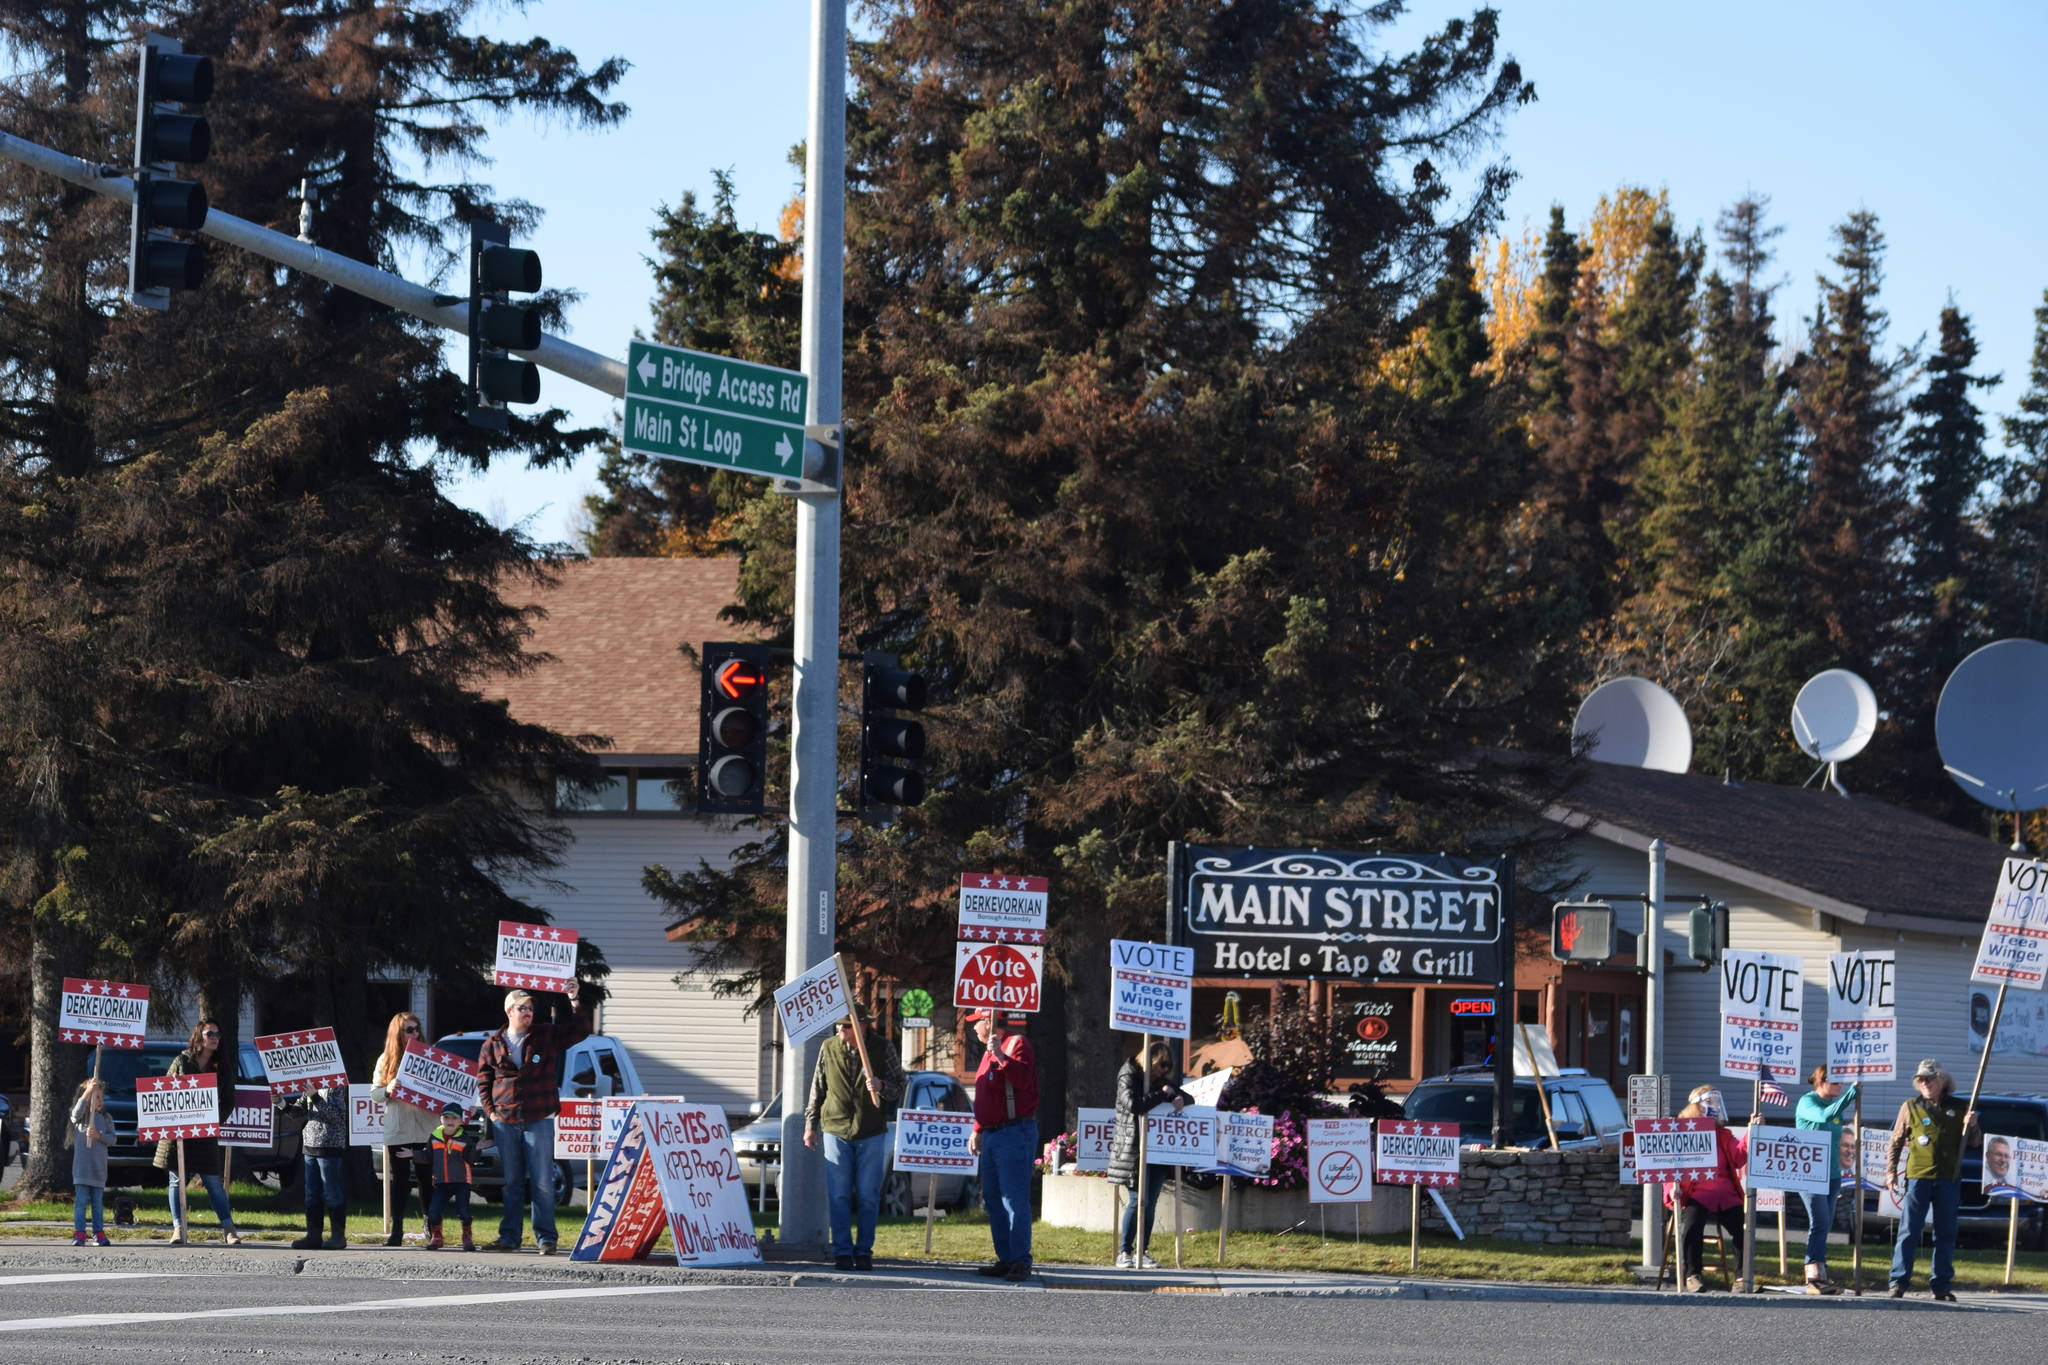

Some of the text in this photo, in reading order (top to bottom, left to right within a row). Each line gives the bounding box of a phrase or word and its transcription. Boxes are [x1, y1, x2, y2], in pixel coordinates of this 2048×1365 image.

[662, 356, 801, 414] Bridge Access Rd
[634, 406, 742, 464] Main St Loop
[965, 895, 1042, 915] DERKEVORKIAN
[1196, 883, 1495, 933] MAIN STREET
[977, 913, 1031, 923] Borough Assembly
[503, 938, 573, 964] DERKEVORKIAN
[2000, 934, 2038, 949] Teea
[1118, 944, 1186, 971] VOTE
[1214, 943, 1474, 978] Hotel Tap & Grill
[1988, 943, 2043, 963] Winger
[975, 954, 1026, 978] Vote
[1129, 981, 1174, 997] Teea
[1724, 959, 1799, 1012] VOTE
[1831, 957, 1895, 1007] VOTE
[784, 973, 840, 1017] PIERCE
[959, 979, 1037, 1009] Today!
[1120, 990, 1183, 1011] Winger
[66, 994, 142, 1020] DERKEVORKIAN
[797, 993, 834, 1023] 2020
[1354, 1001, 1393, 1016] Tito's
[1450, 1001, 1492, 1013] OPEN
[78, 1018, 131, 1030] Borough Assembly
[1739, 1026, 1784, 1042] Teea
[1842, 1030, 1880, 1041] Teea
[264, 1043, 336, 1069] DERKEVORKIAN
[1731, 1037, 1793, 1056] Winger
[1835, 1042, 1888, 1057] Winger
[404, 1055, 478, 1096] DERKEVORKIAN
[142, 1090, 213, 1112] DERKEVORKIAN
[155, 1111, 205, 1122] Borough Assembly
[226, 1107, 270, 1126] ARRE
[1229, 1114, 1267, 1127] Charlie
[220, 1130, 268, 1139] CITY COUNCIL
[644, 1111, 684, 1146] Vote
[677, 1111, 710, 1144] YES
[711, 1123, 728, 1141] on
[915, 1122, 962, 1135] Teea
[1147, 1119, 1209, 1136] PIERCE
[1223, 1125, 1272, 1139] PIERCE
[558, 1133, 594, 1143] KENAI
[906, 1132, 969, 1149] Winger
[1156, 1135, 1199, 1147] 2020
[1382, 1136, 1455, 1157] DERKEVORKIAN
[1640, 1132, 1712, 1154] DERKEVORKIAN
[1229, 1144, 1265, 1155] Borough
[1232, 1153, 1261, 1163] Mayor
[1756, 1142, 1823, 1162] PIERCE
[663, 1147, 740, 1189] KPB Prop 2
[1766, 1159, 1811, 1174] 2020
[689, 1183, 712, 1208] for
[670, 1213, 698, 1256] NO
[722, 1221, 760, 1259] Voting
